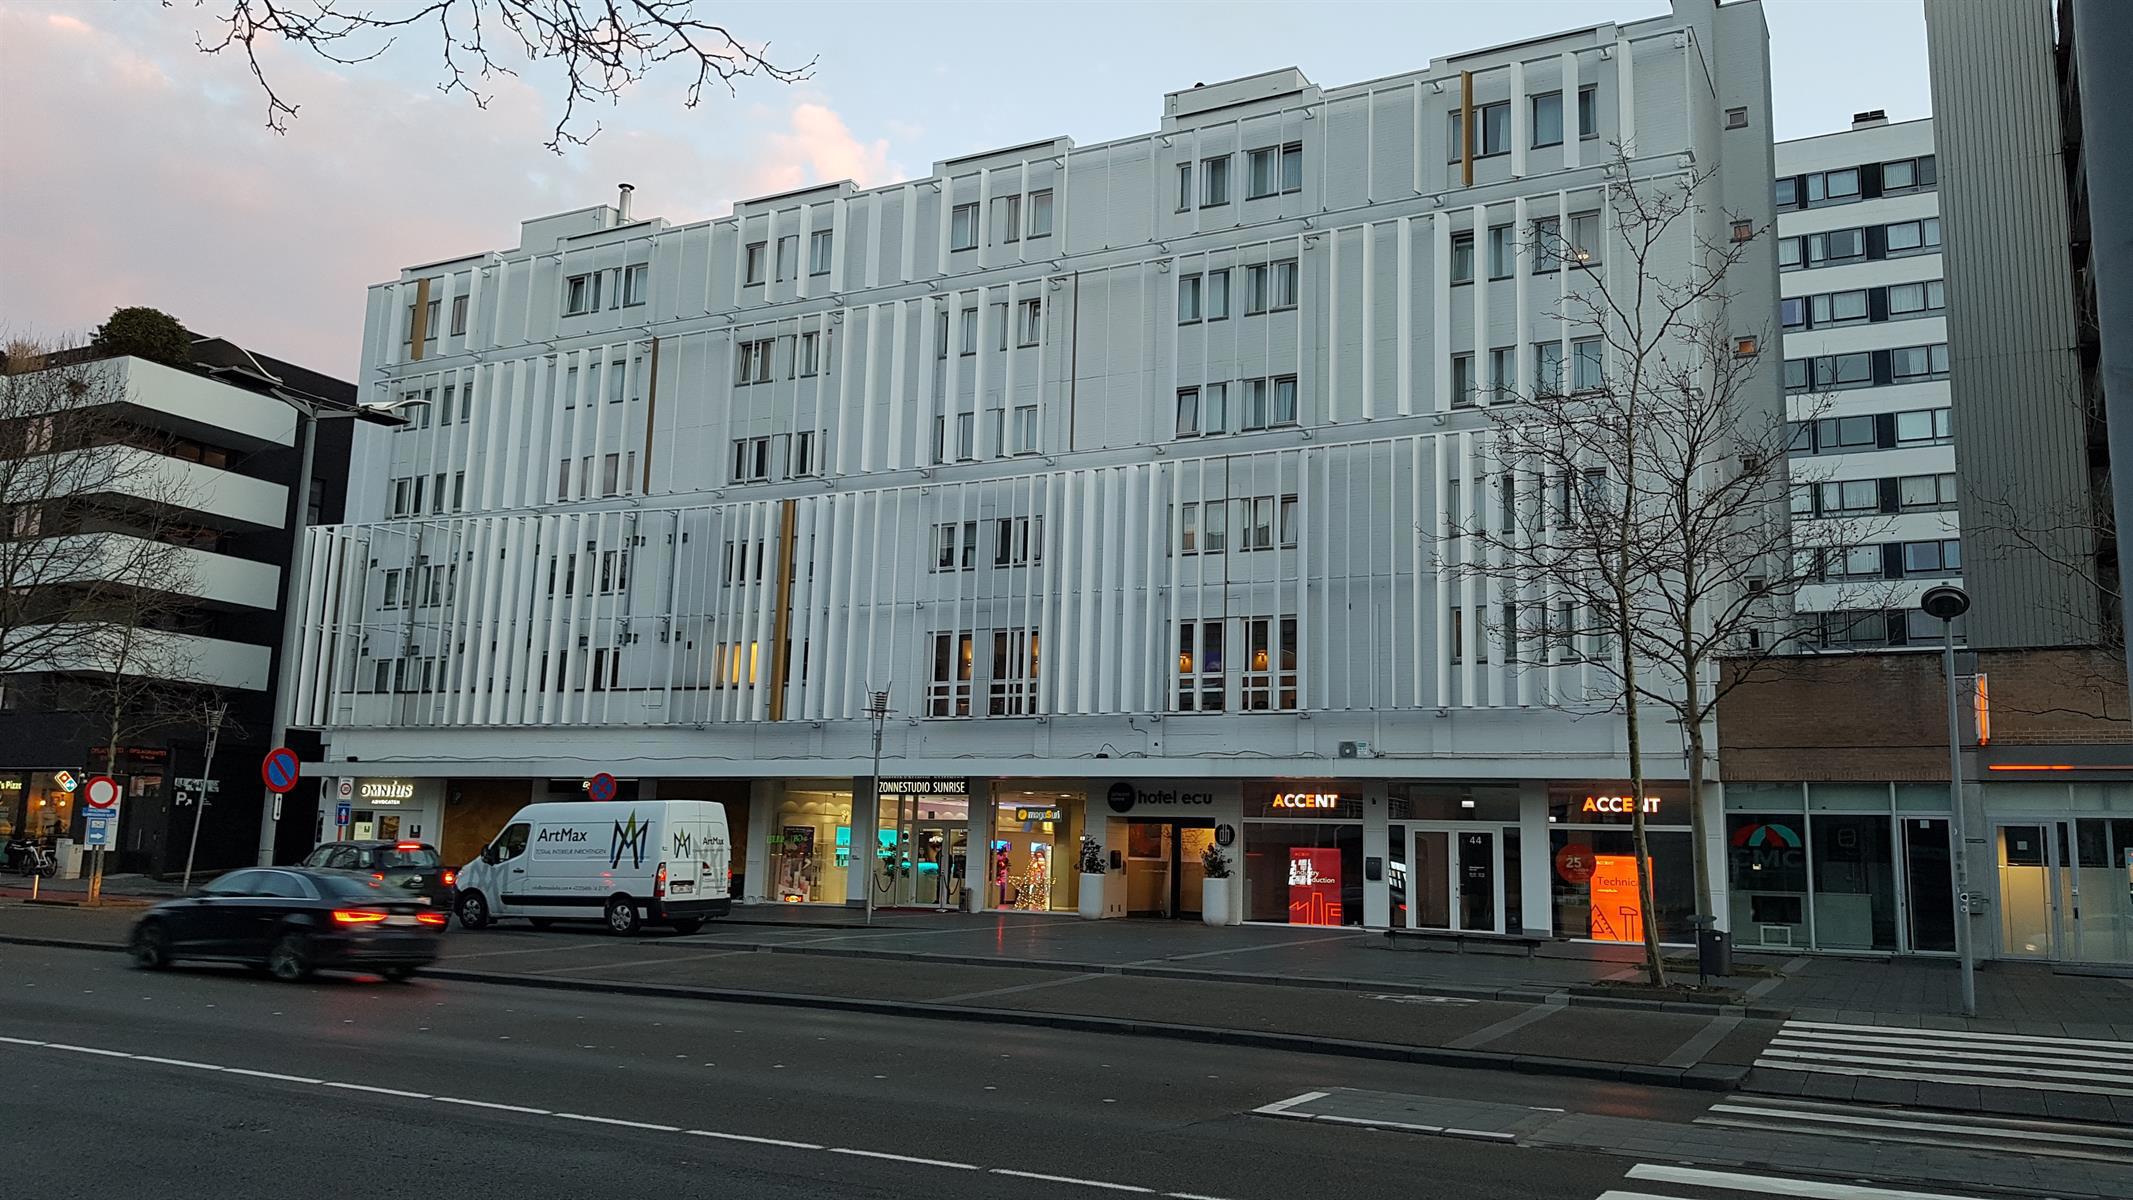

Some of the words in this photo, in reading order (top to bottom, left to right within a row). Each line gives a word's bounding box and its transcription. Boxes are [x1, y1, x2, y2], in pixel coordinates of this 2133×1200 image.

[878, 781, 930, 793] ZONNESTUDIO
[933, 781, 965, 793] SUNRISE
[175, 792, 188, 806] P
[1137, 790, 1177, 804] hotel
[1181, 793, 1212, 804] ecu
[1272, 793, 1338, 808] ACCENT
[537, 828, 588, 842] ArtMax
[1469, 836, 1482, 844] 44
[702, 837, 724, 846] ArtMax
[1566, 857, 1582, 868] 25
[1597, 876, 1638, 888] Technic
